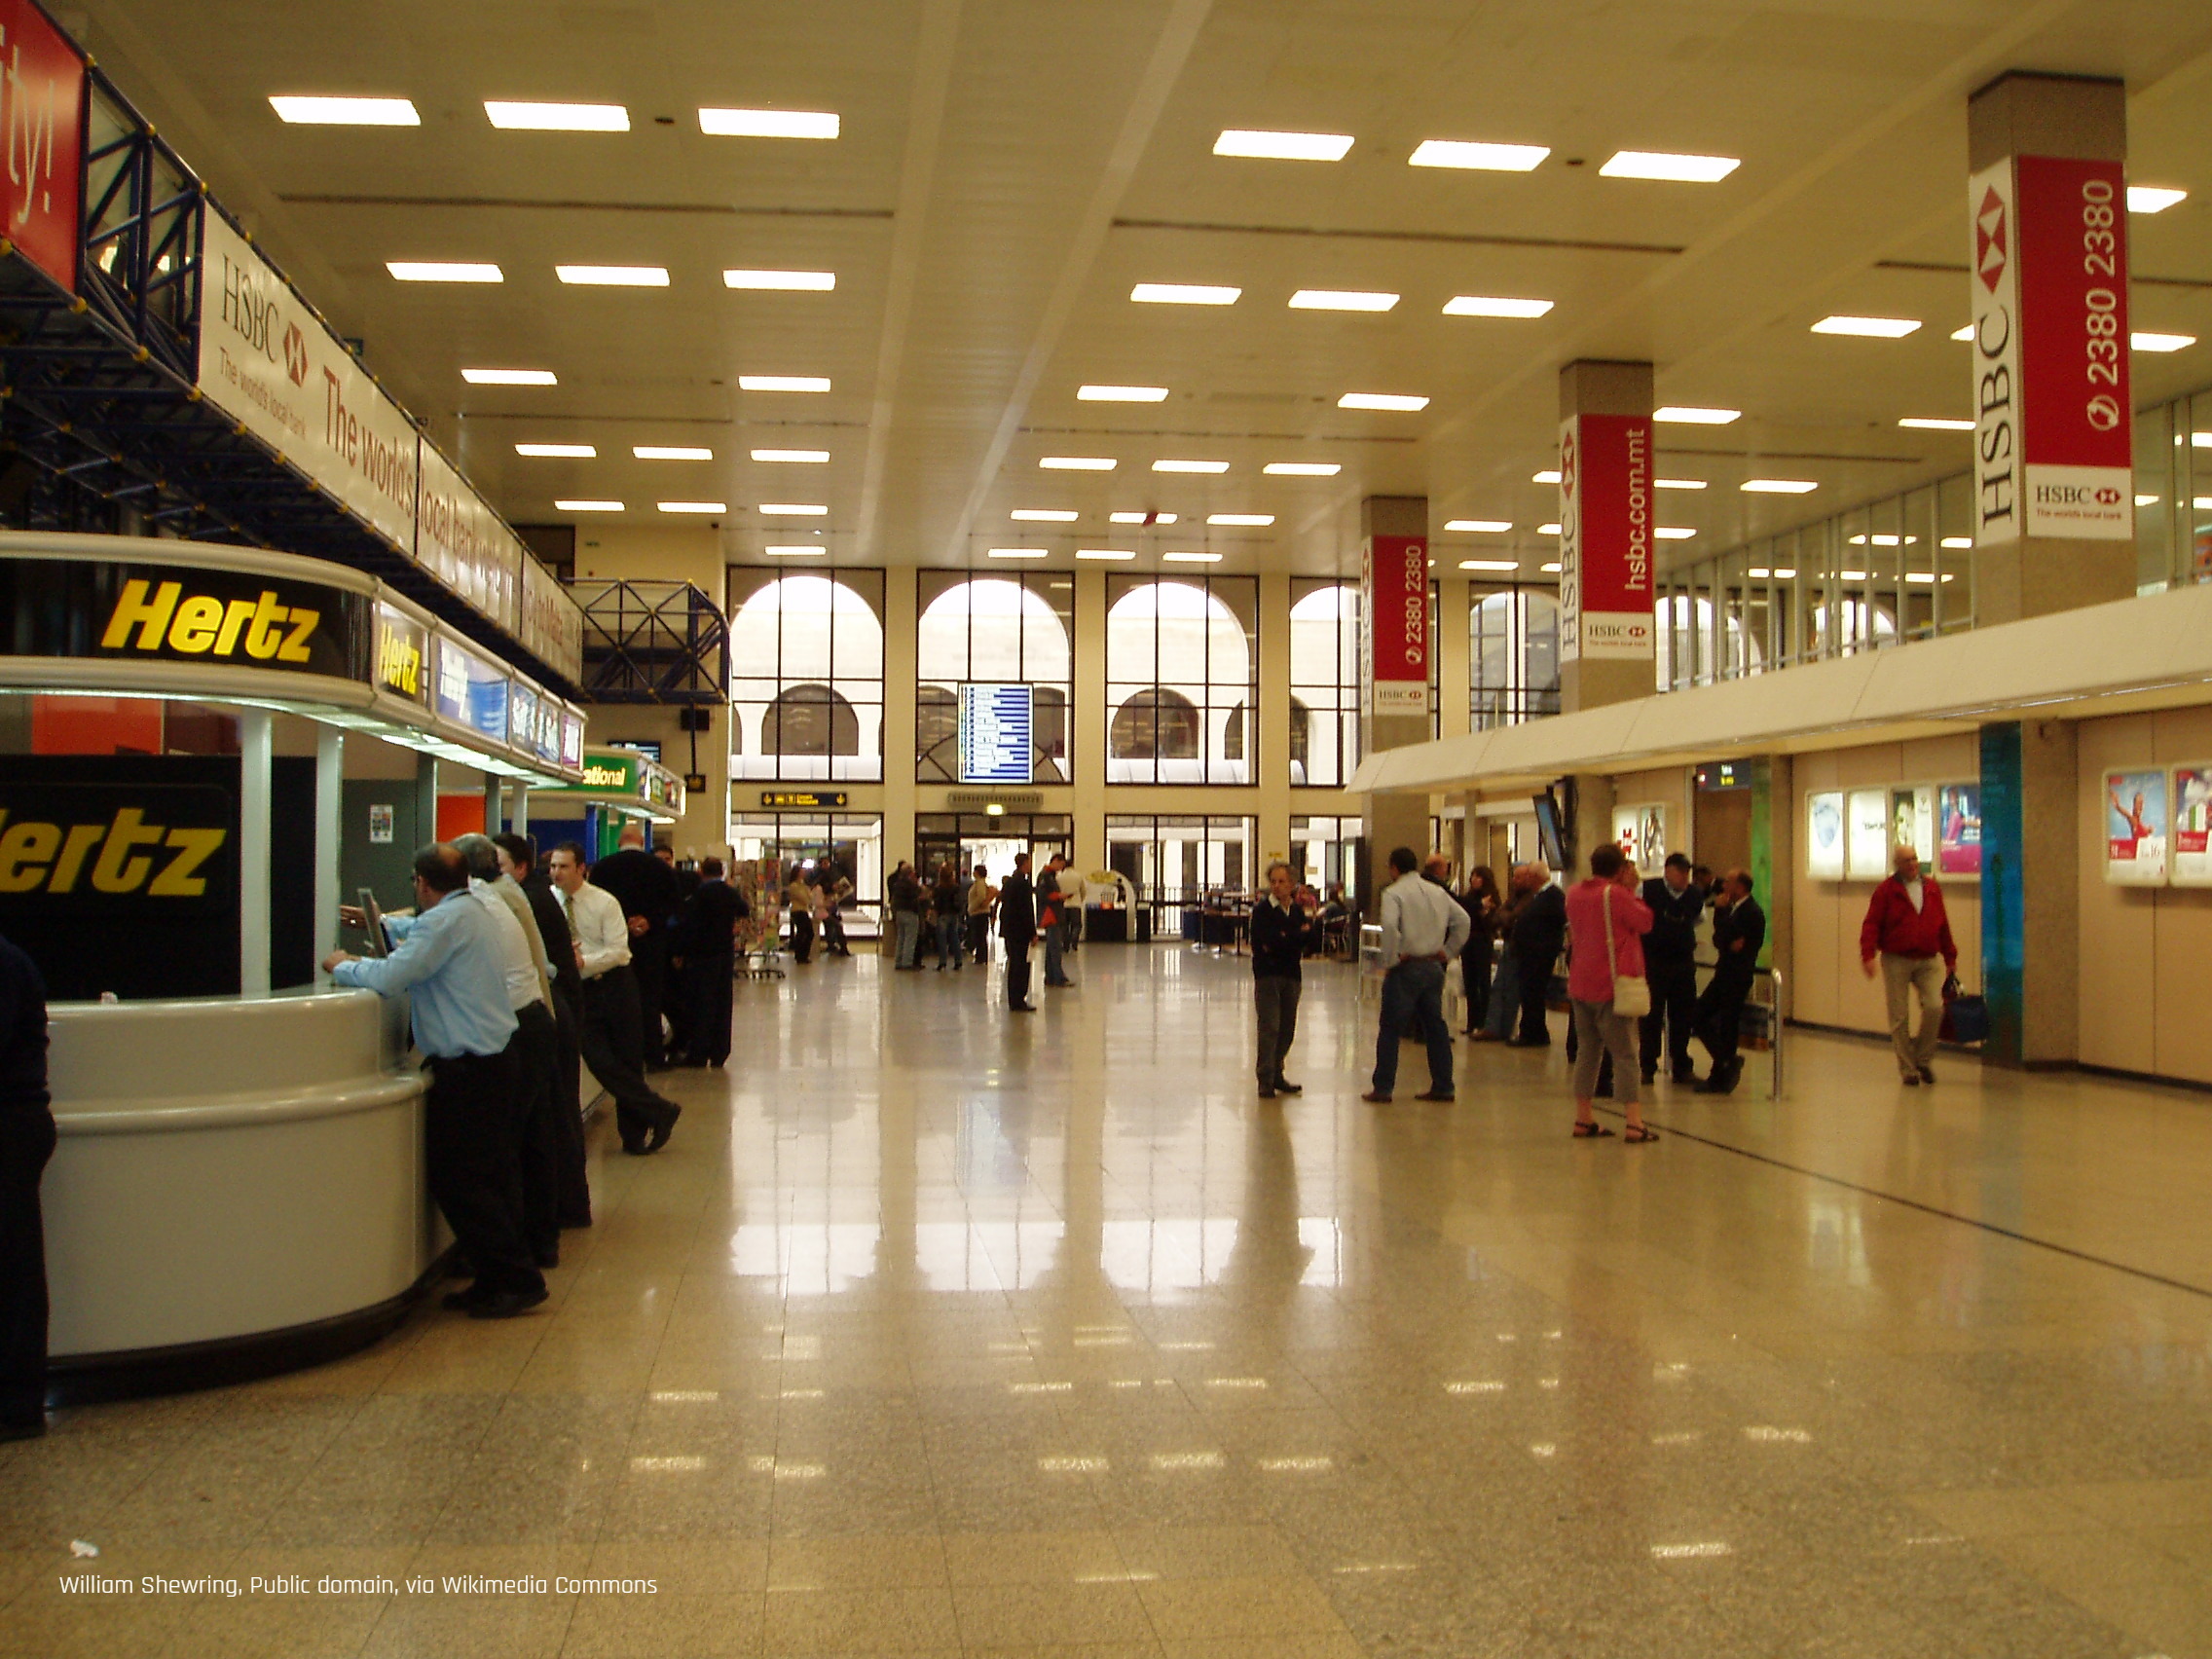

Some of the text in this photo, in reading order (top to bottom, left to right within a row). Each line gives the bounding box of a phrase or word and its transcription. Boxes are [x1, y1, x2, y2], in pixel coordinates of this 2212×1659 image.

[222, 253, 279, 364] HSBC
[2083, 180, 2119, 387] 2380 2380
[324, 365, 356, 467] The
[1979, 304, 2013, 530] HSBC
[1624, 428, 1645, 592] hsbc.com.mt
[2036, 485, 2090, 504] HSBC
[101, 578, 320, 663] Hertz
[1405, 545, 1422, 645] 2380 2380
[1562, 510, 1576, 652] HSBC
[379, 621, 421, 696] Hertz
[583, 764, 626, 787] ational
[0, 807, 227, 897] ertz
